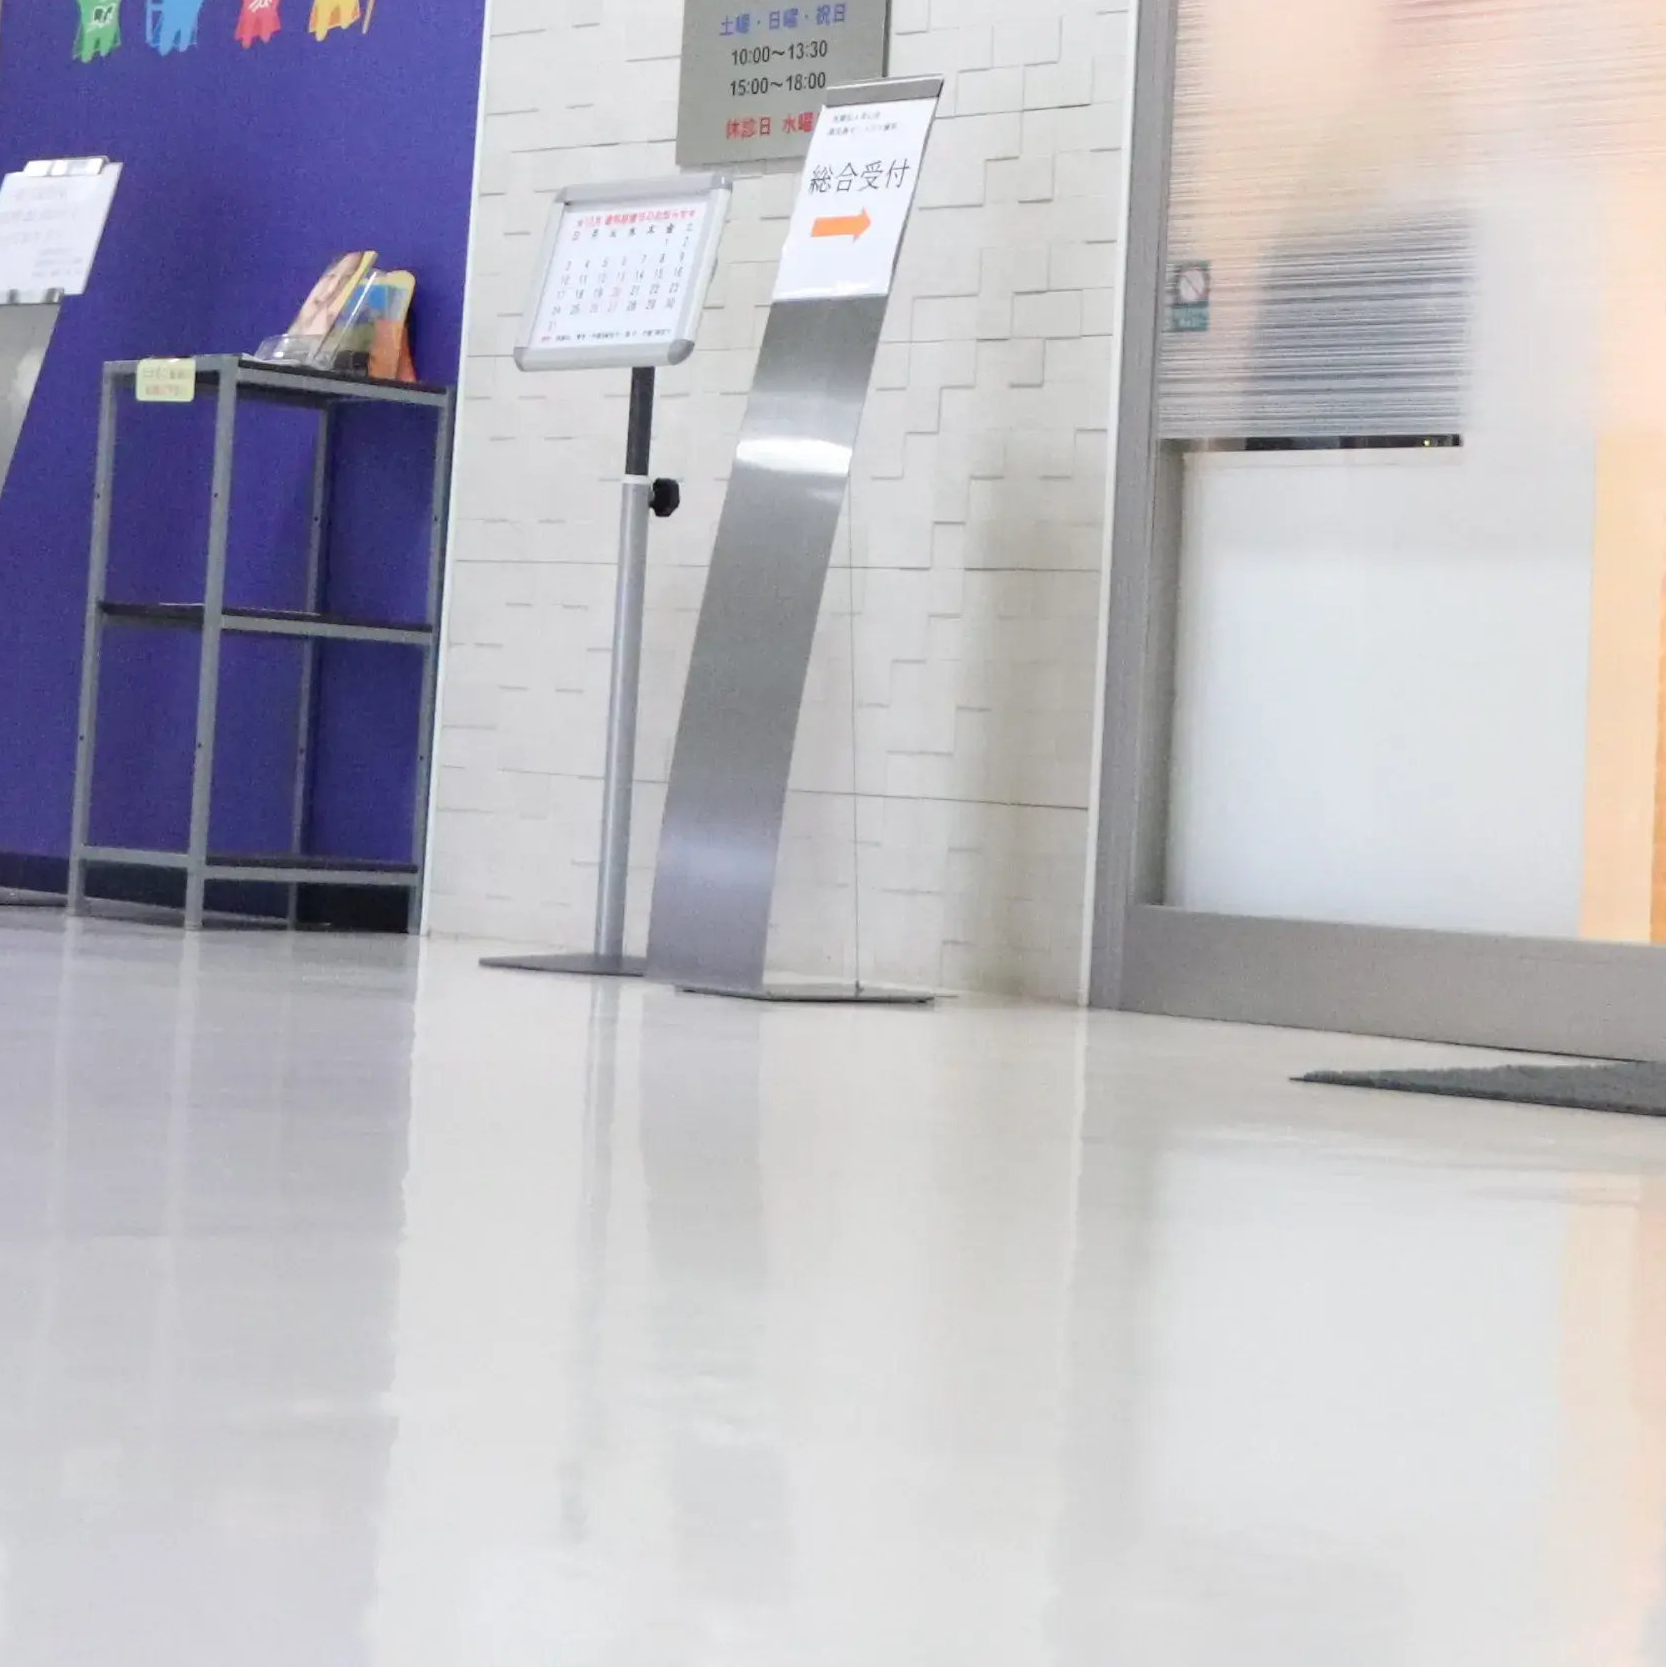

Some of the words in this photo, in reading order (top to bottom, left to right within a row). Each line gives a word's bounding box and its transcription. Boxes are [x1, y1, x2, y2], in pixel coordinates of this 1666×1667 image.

[783, 111, 818, 134] 水曜
[808, 159, 911, 194] 総合受付
